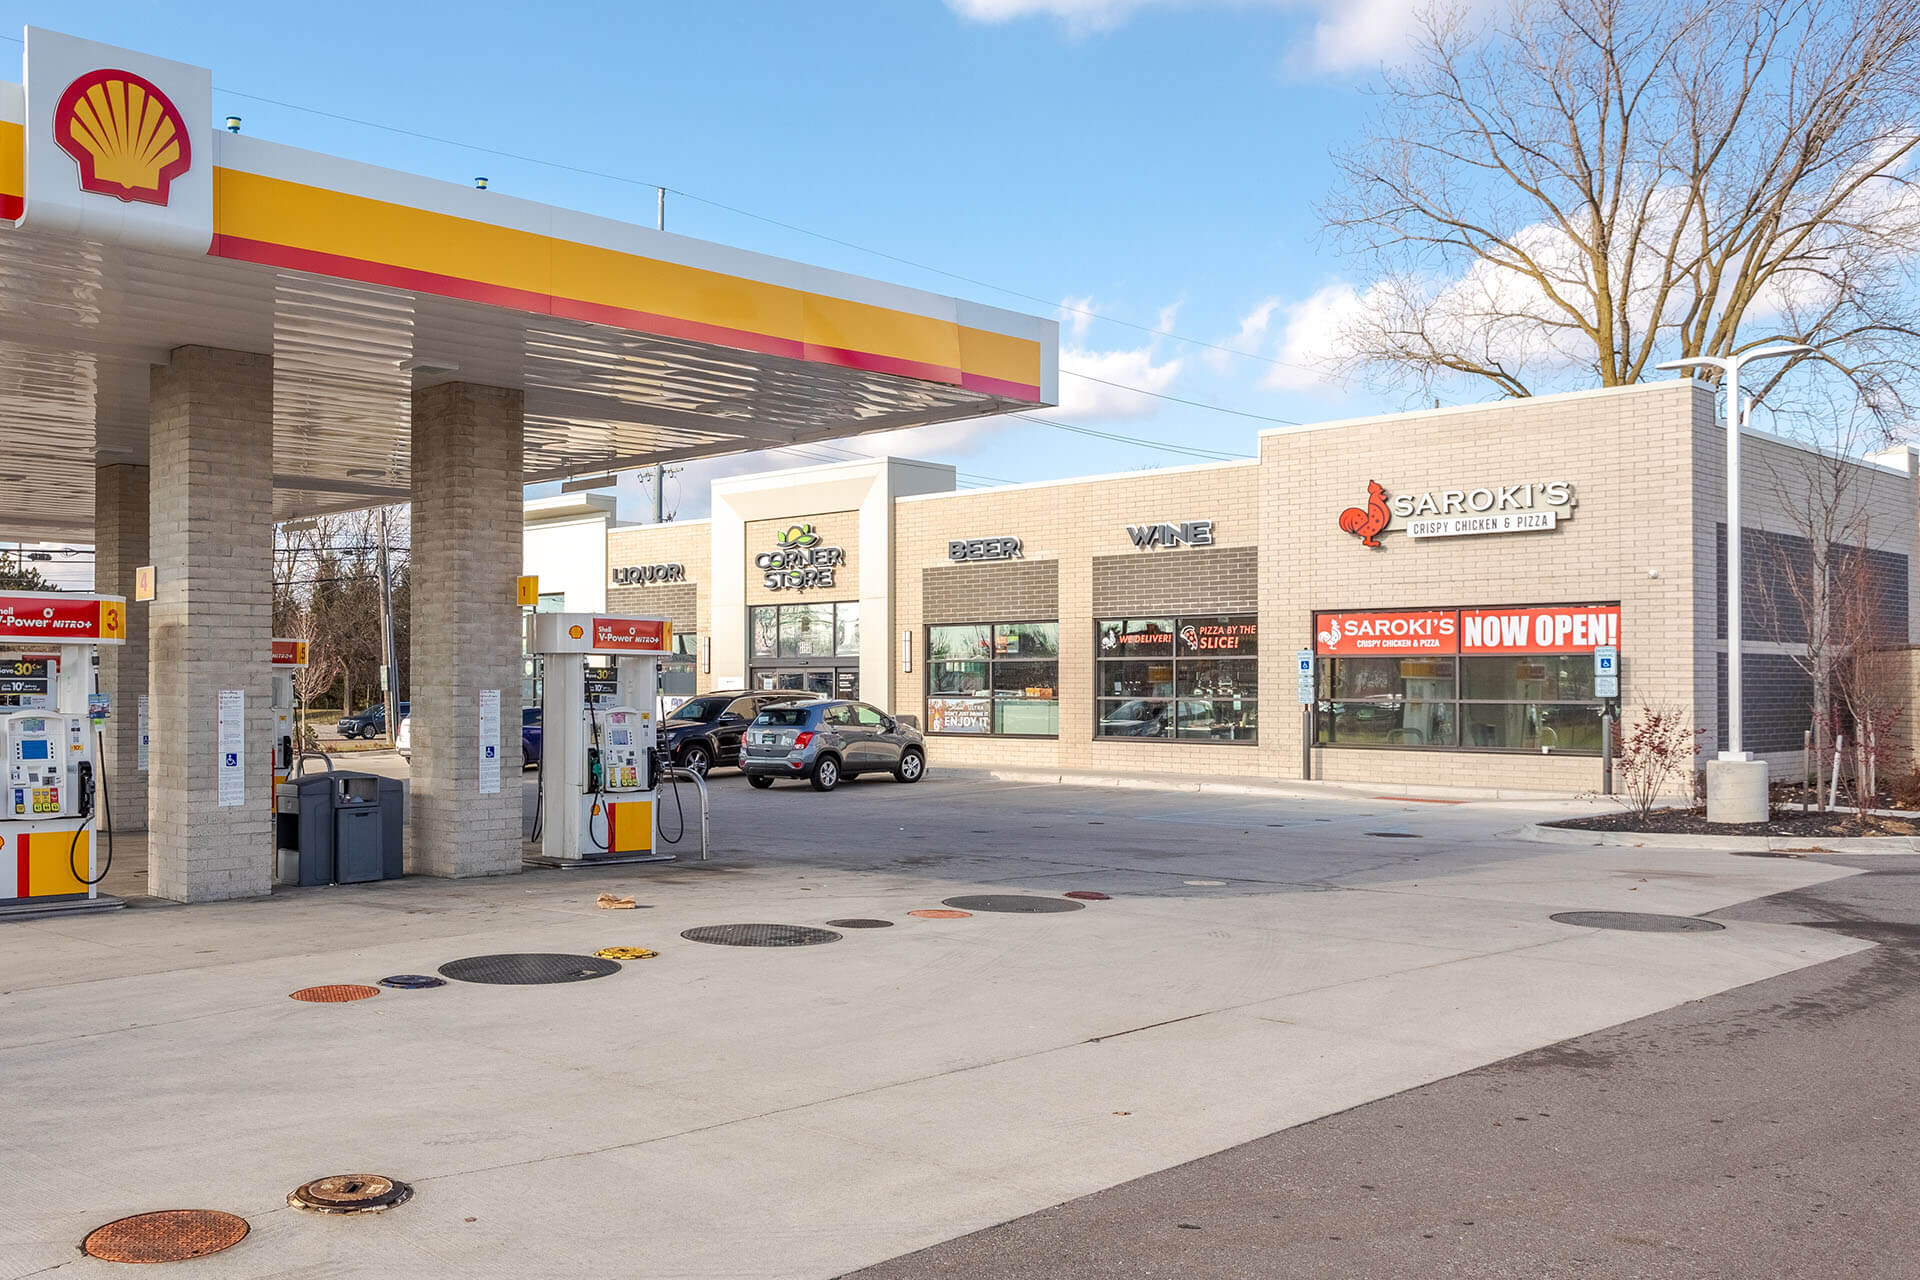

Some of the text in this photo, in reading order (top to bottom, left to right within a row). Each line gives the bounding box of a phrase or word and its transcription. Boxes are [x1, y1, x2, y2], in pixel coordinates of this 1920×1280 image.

[1393, 480, 1570, 518] SAROKI'S
[1126, 520, 1212, 548] WINE
[1413, 514, 1549, 535] CRISPY CHICKEN & PIZZA
[755, 547, 844, 569] CORNER
[949, 536, 1022, 561] BEER
[139, 572, 147, 592] 4
[612, 562, 684, 584] LIQUOR
[763, 567, 833, 589] STORE
[106, 608, 119, 632] 3
[598, 625, 612, 633] Shell
[1199, 624, 1257, 635] PIZZA BY THE
[1343, 618, 1455, 636] SAROKI'S
[1464, 613, 1617, 647] NOW OPEN!
[598, 632, 633, 643] V-Power
[1119, 633, 1172, 644] WE DELIVER!
[1199, 636, 1239, 649] SLICE!
[1356, 638, 1440, 648] CRISPY CHICKEN & PIZZA
[944, 716, 989, 728] ENJOY IT
